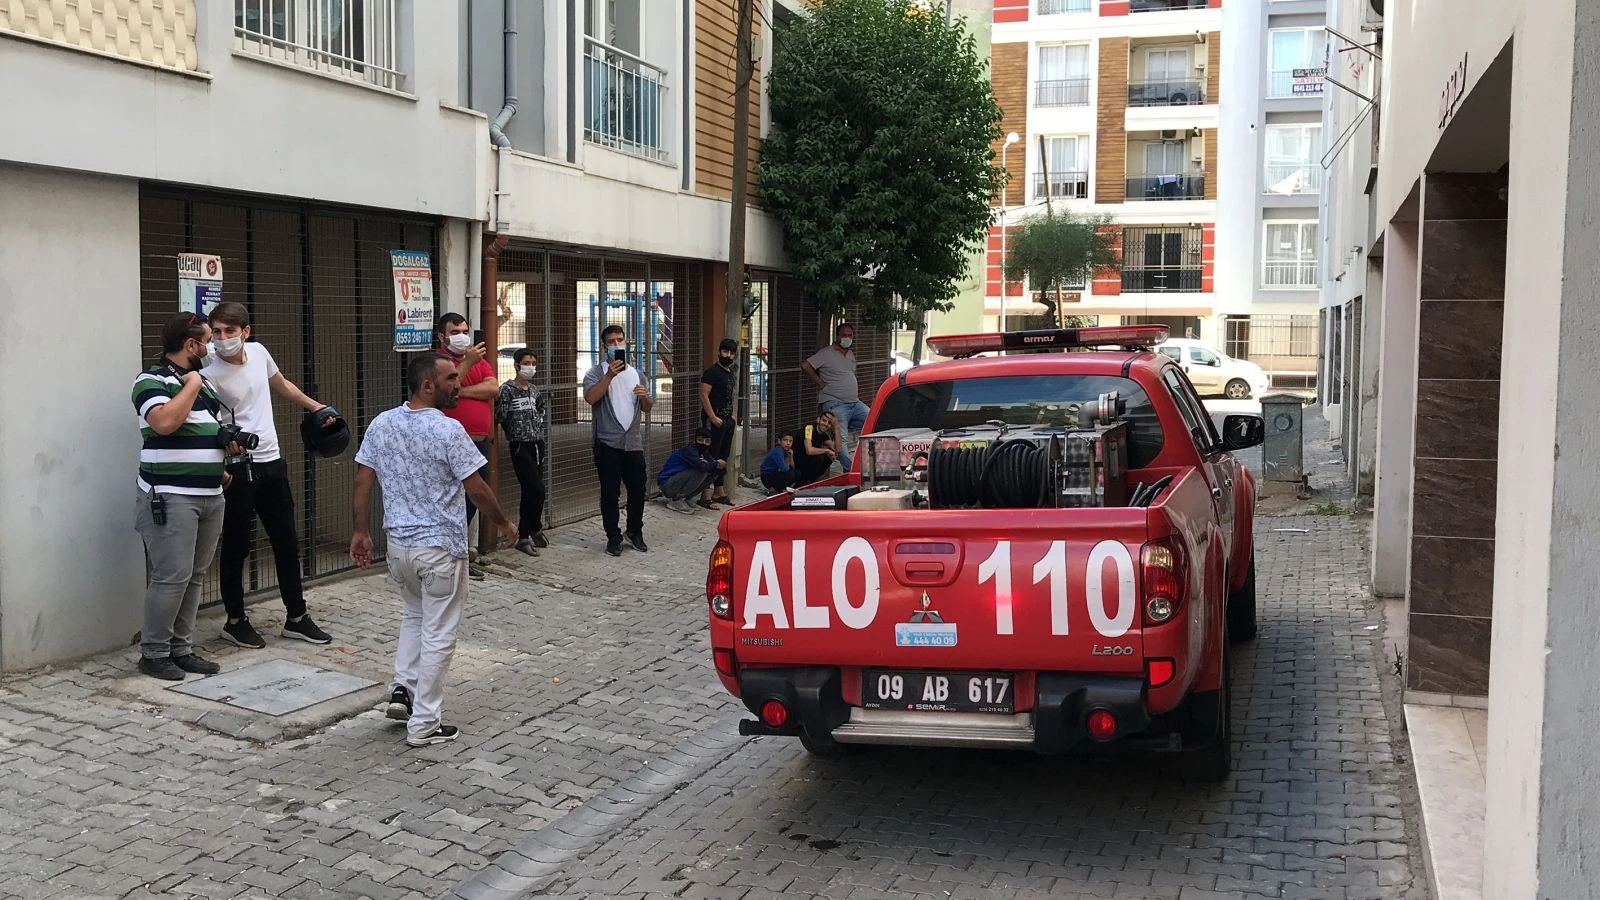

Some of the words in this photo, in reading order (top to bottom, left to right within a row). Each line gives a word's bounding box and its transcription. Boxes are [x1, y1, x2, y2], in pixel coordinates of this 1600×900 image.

[407, 308, 433, 319] Labirent
[396, 332, 411, 344] 0553
[902, 442, 930, 452] KÖPÜK
[741, 536, 880, 630] ALO
[978, 539, 1136, 638] 110
[741, 637, 784, 647] MITSUBISHI
[913, 636, 930, 645] 444
[931, 636, 942, 645] 40
[943, 636, 955, 645] 09
[1091, 644, 1134, 656] L200
[877, 674, 904, 700] 09
[921, 675, 950, 702] AB
[968, 677, 1010, 704] 617
